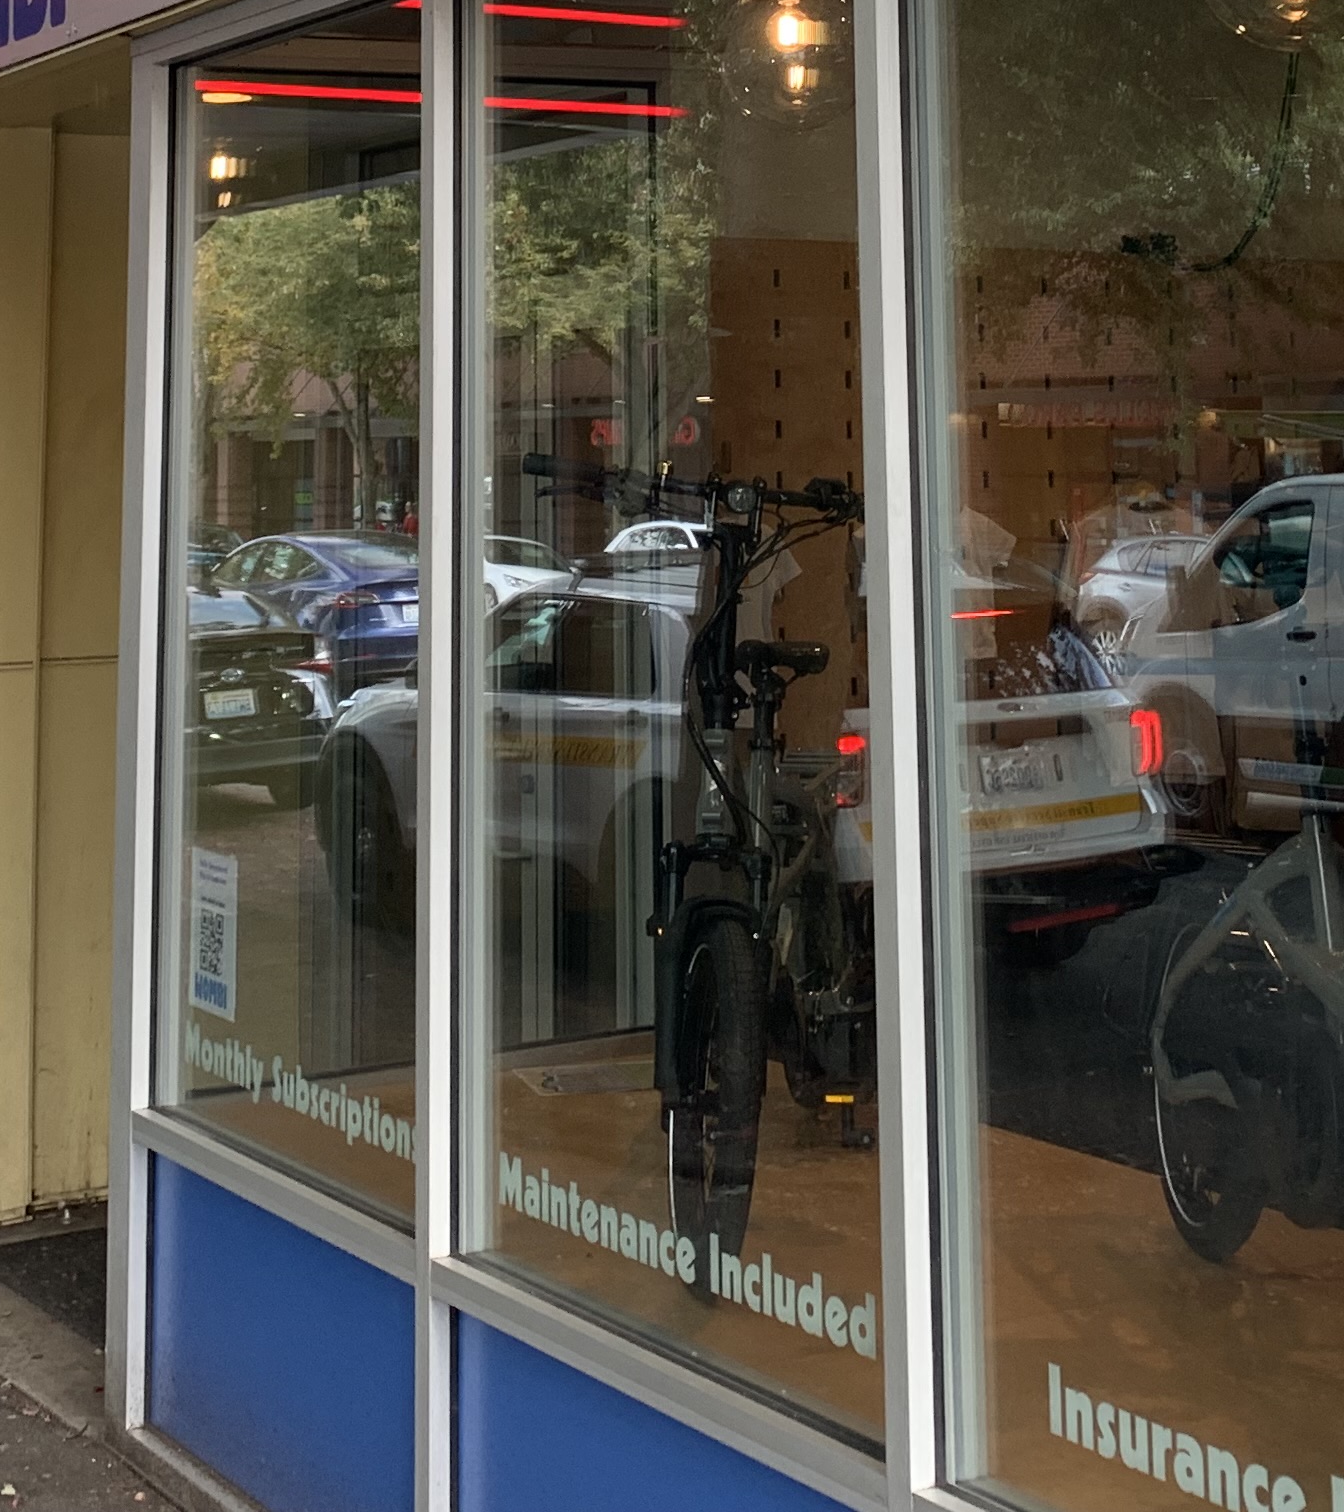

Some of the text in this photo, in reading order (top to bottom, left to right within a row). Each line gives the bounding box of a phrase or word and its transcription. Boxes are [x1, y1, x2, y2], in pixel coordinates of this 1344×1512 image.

[185, 1020, 264, 1104] Monthly
[498, 1151, 877, 1361] Maintenance Included
[1048, 1362, 1307, 1512] Insurance
